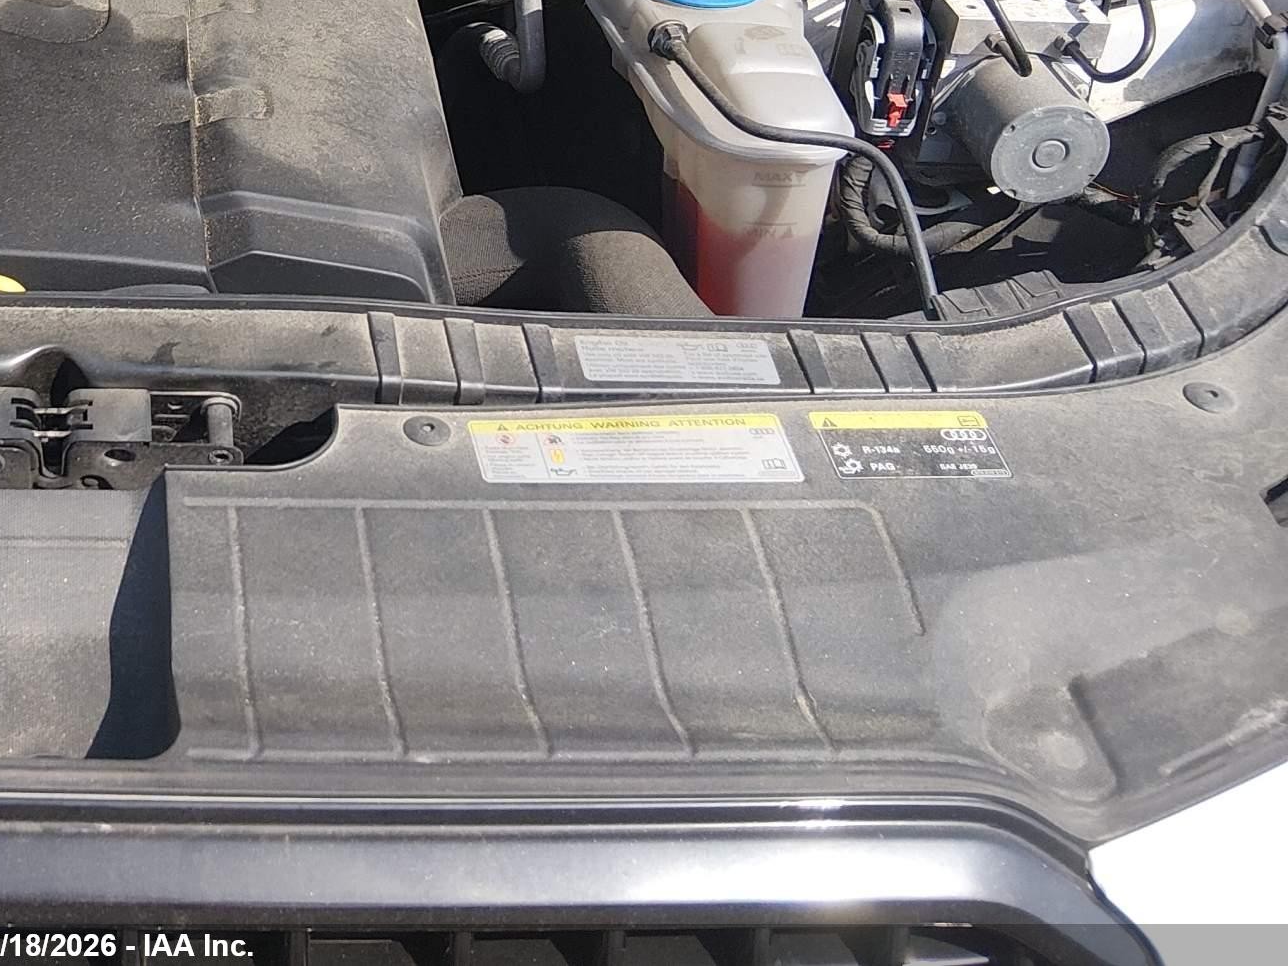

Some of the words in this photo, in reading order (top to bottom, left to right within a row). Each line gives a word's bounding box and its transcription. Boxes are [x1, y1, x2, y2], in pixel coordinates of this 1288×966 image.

[516, 422, 584, 431] ACHTUNG
[591, 419, 660, 428] WARNING
[668, 418, 746, 427] ATTENTION
[861, 445, 901, 455] R-134a
[870, 462, 896, 472] PAG
